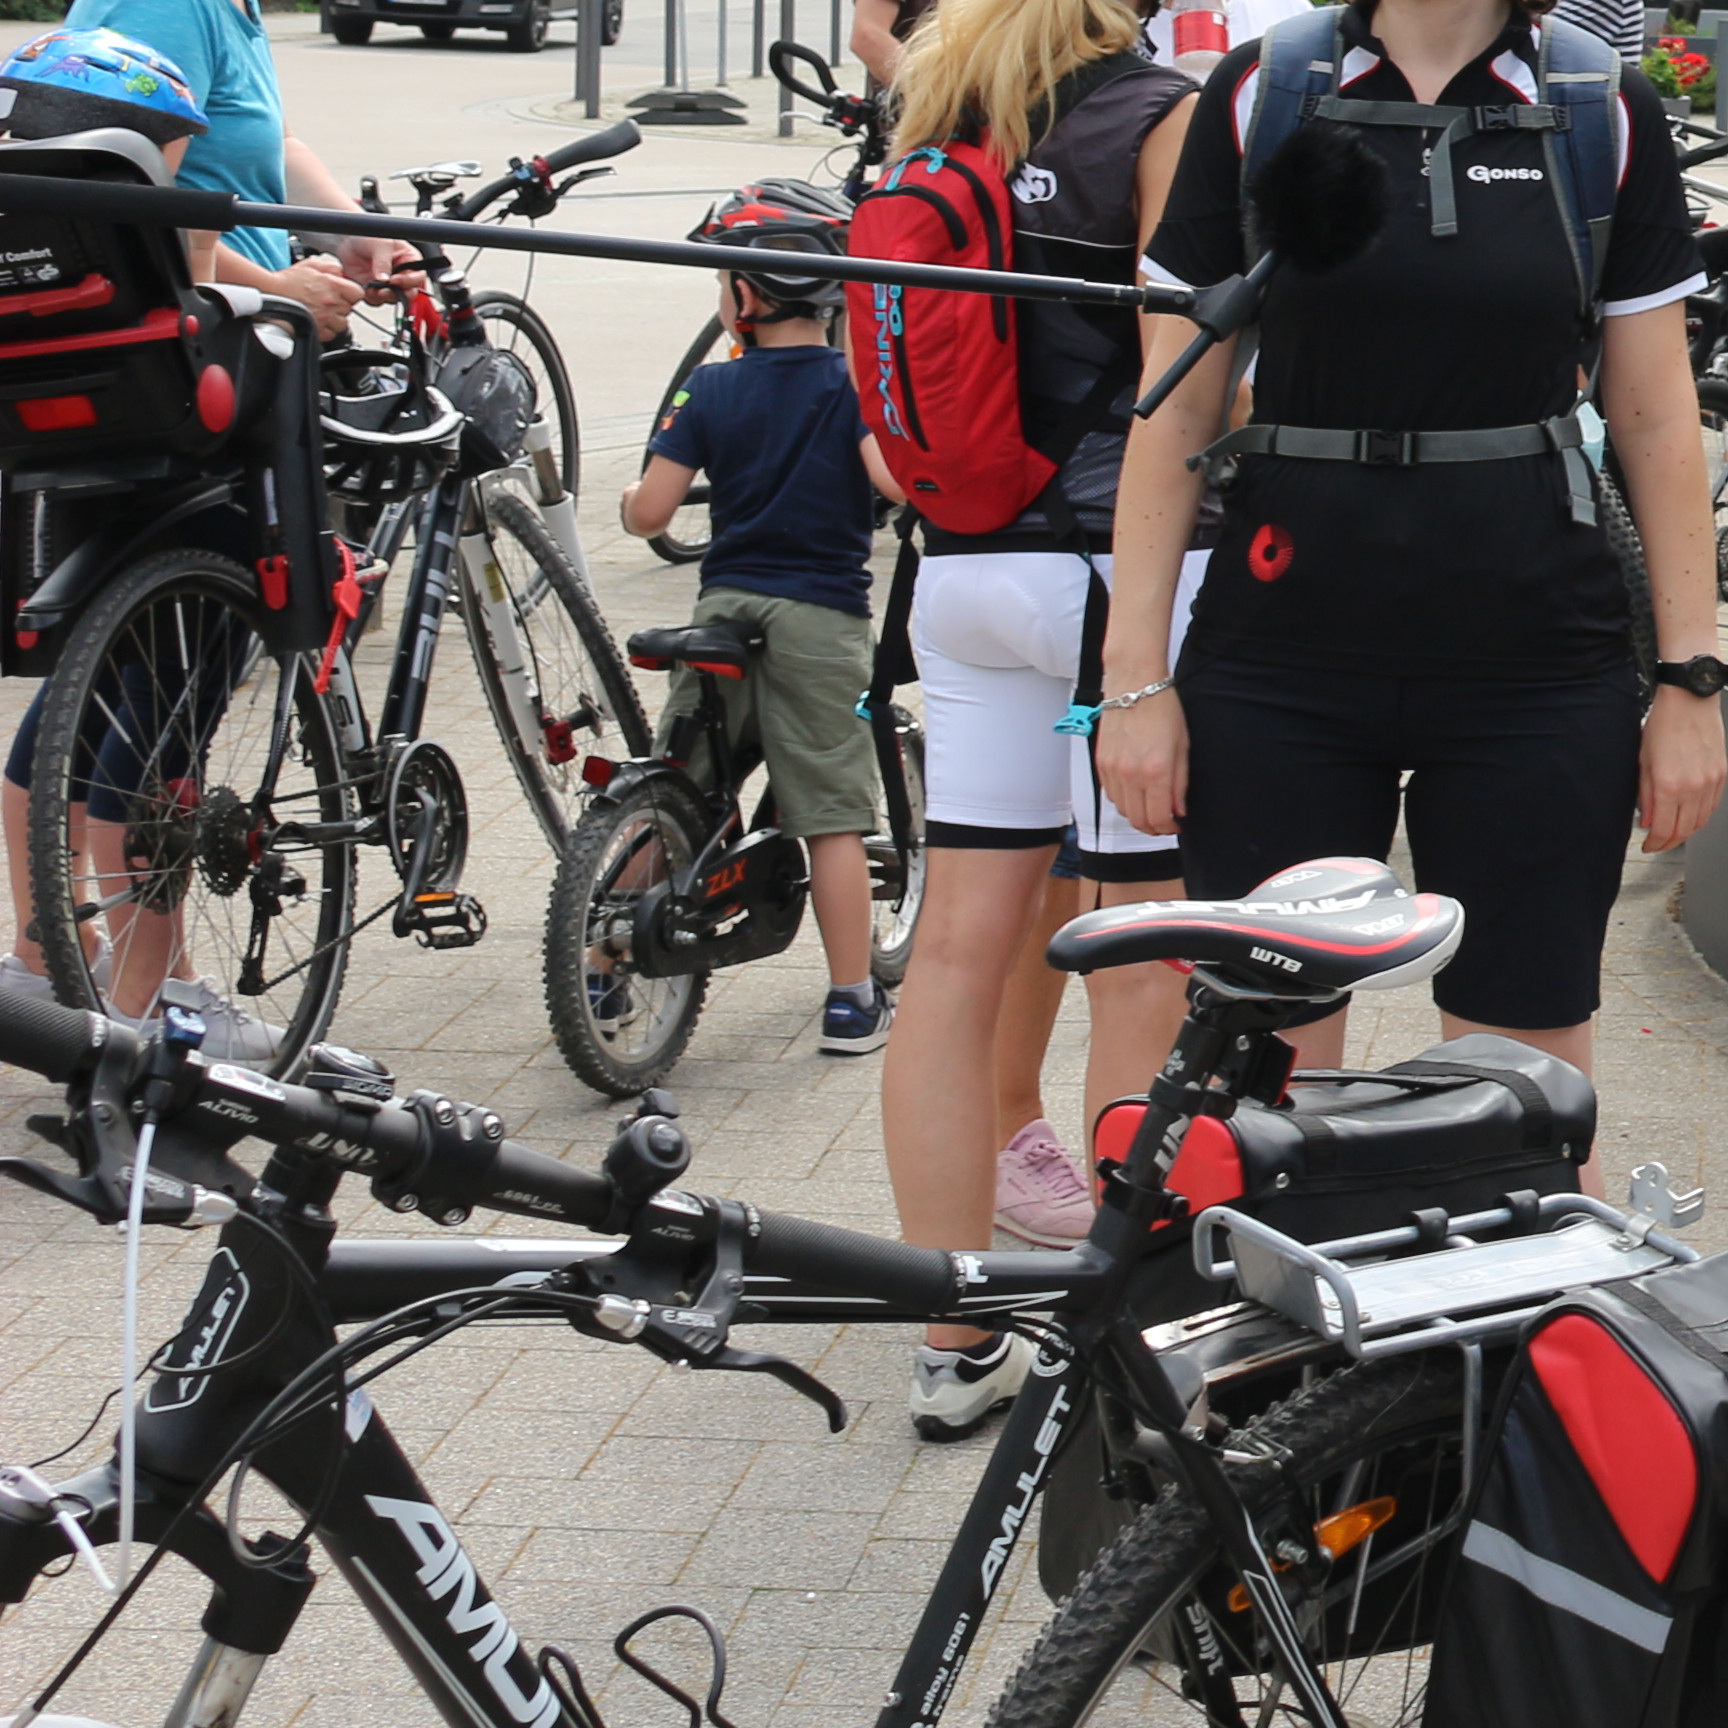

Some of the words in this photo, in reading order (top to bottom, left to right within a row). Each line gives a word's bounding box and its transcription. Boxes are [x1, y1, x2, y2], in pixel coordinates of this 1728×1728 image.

[704, 858, 749, 899] ZLX
[1250, 946, 1303, 973] WTB
[198, 1100, 260, 1124] ALIVIO
[980, 1384, 1071, 1601] AMULET
[919, 1666, 950, 1716] alloy
[942, 1612, 971, 1662] 6061
